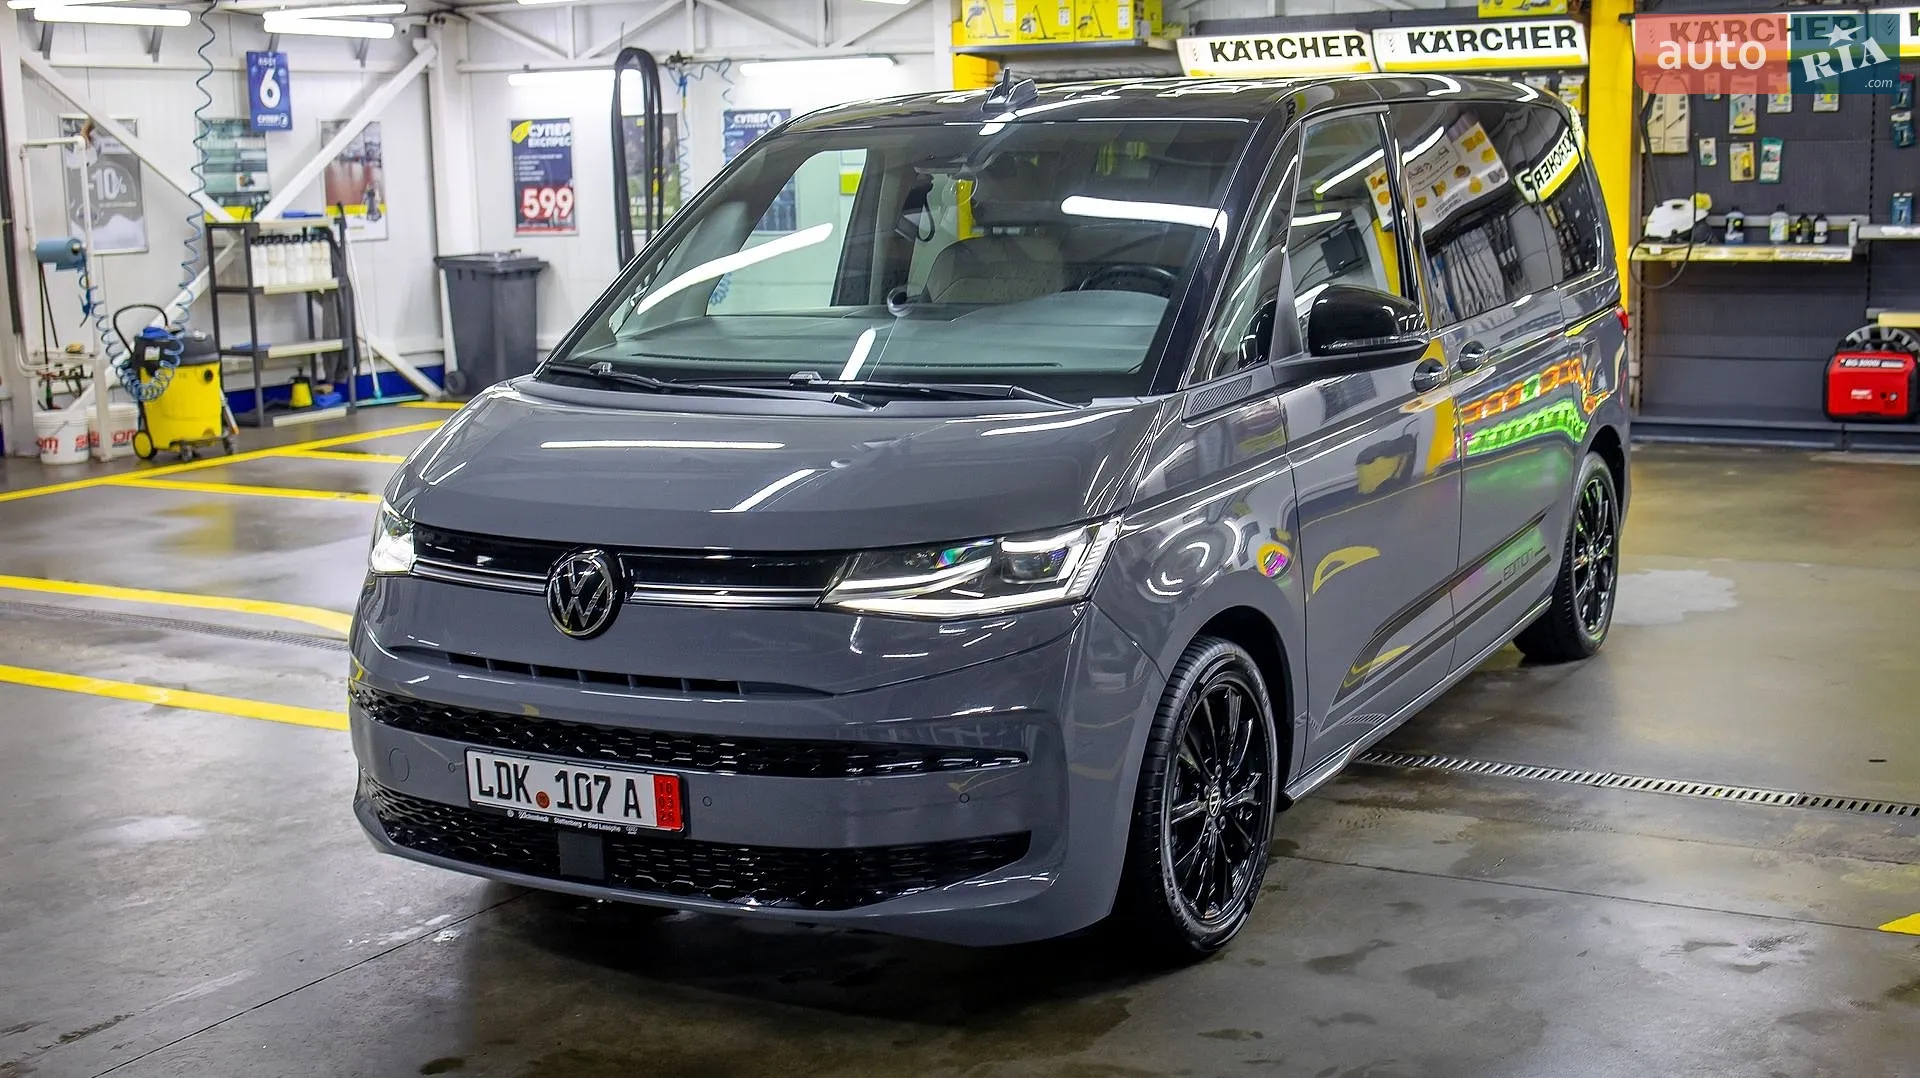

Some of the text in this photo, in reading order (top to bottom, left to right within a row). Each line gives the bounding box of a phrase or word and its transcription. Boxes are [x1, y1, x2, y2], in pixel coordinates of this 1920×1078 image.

[1209, 34, 1367, 64] KÄRCHER
[1408, 24, 1578, 55] KÄRCHER
[259, 67, 281, 109] 6
[527, 123, 571, 138] СУПЕР
[523, 187, 574, 219] 599
[475, 757, 642, 819] LDK 107 A
